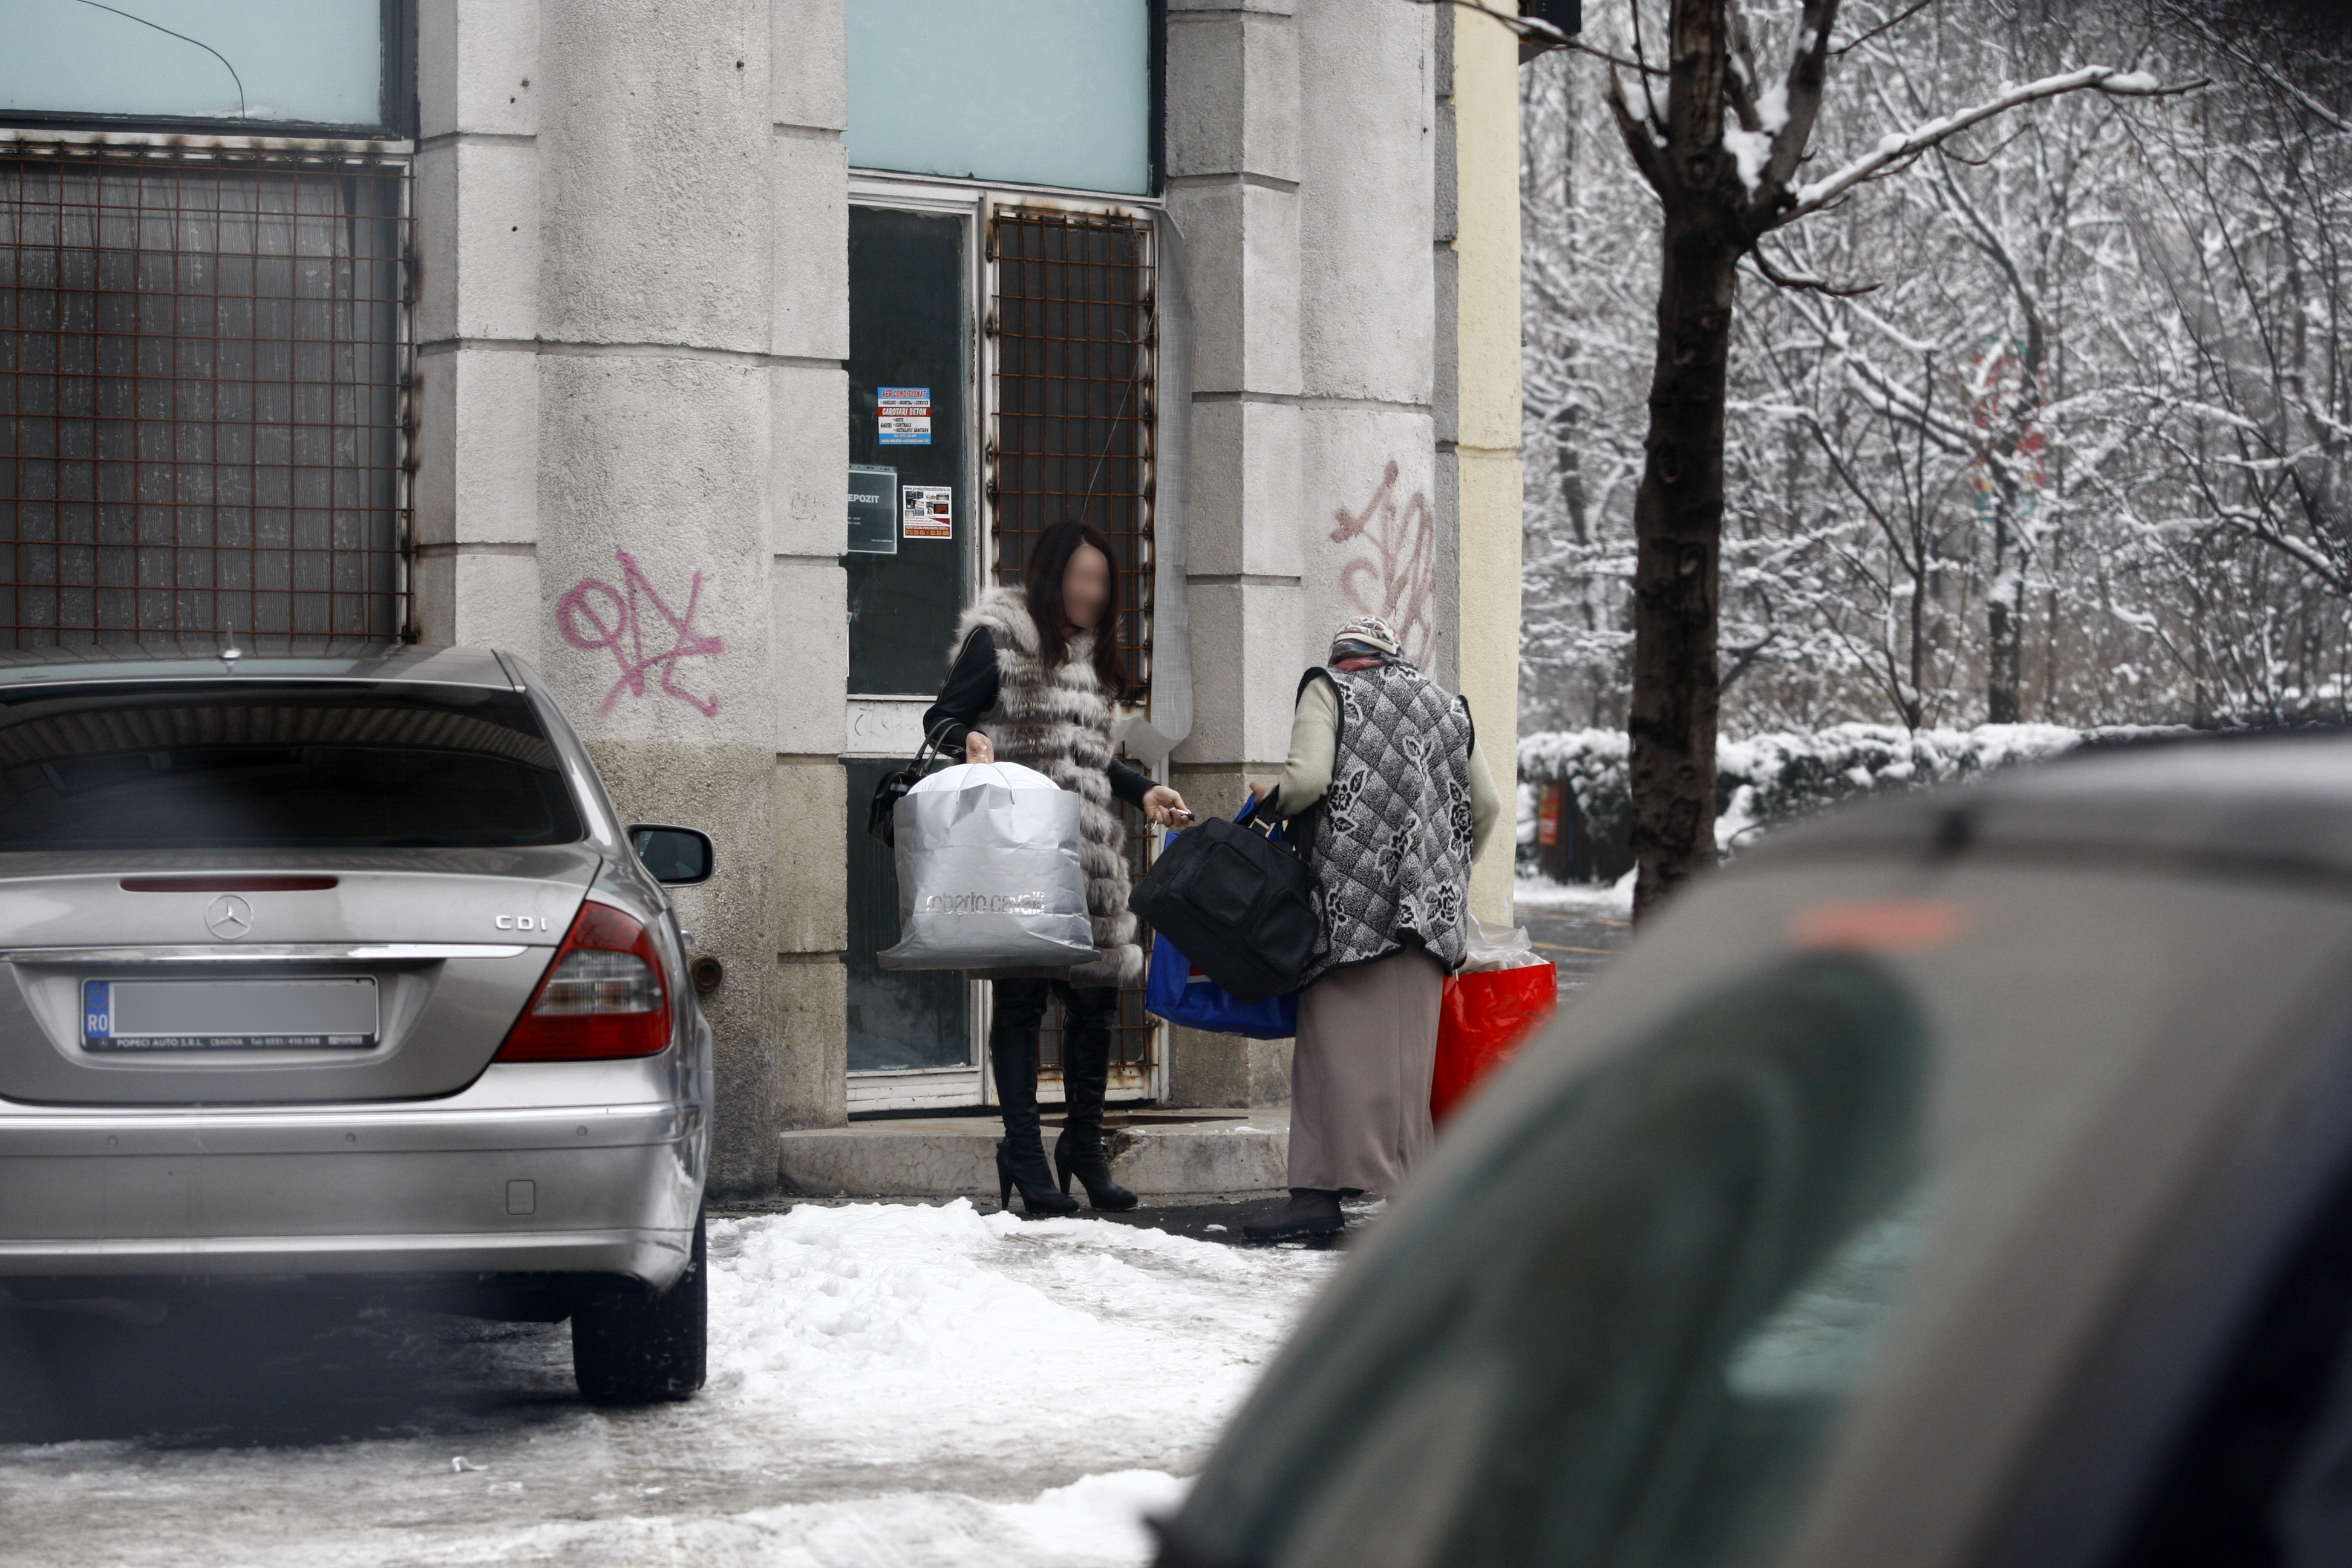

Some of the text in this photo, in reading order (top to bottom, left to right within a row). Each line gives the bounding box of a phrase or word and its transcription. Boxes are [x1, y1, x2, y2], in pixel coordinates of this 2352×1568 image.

[882, 390, 926, 398] AER CONDITIONAT
[848, 494, 880, 503] EPOZIT
[926, 892, 987, 915] roberto
[495, 915, 547, 931] CDI
[88, 1014, 108, 1032] RO
[117, 1039, 150, 1047] POPECI
